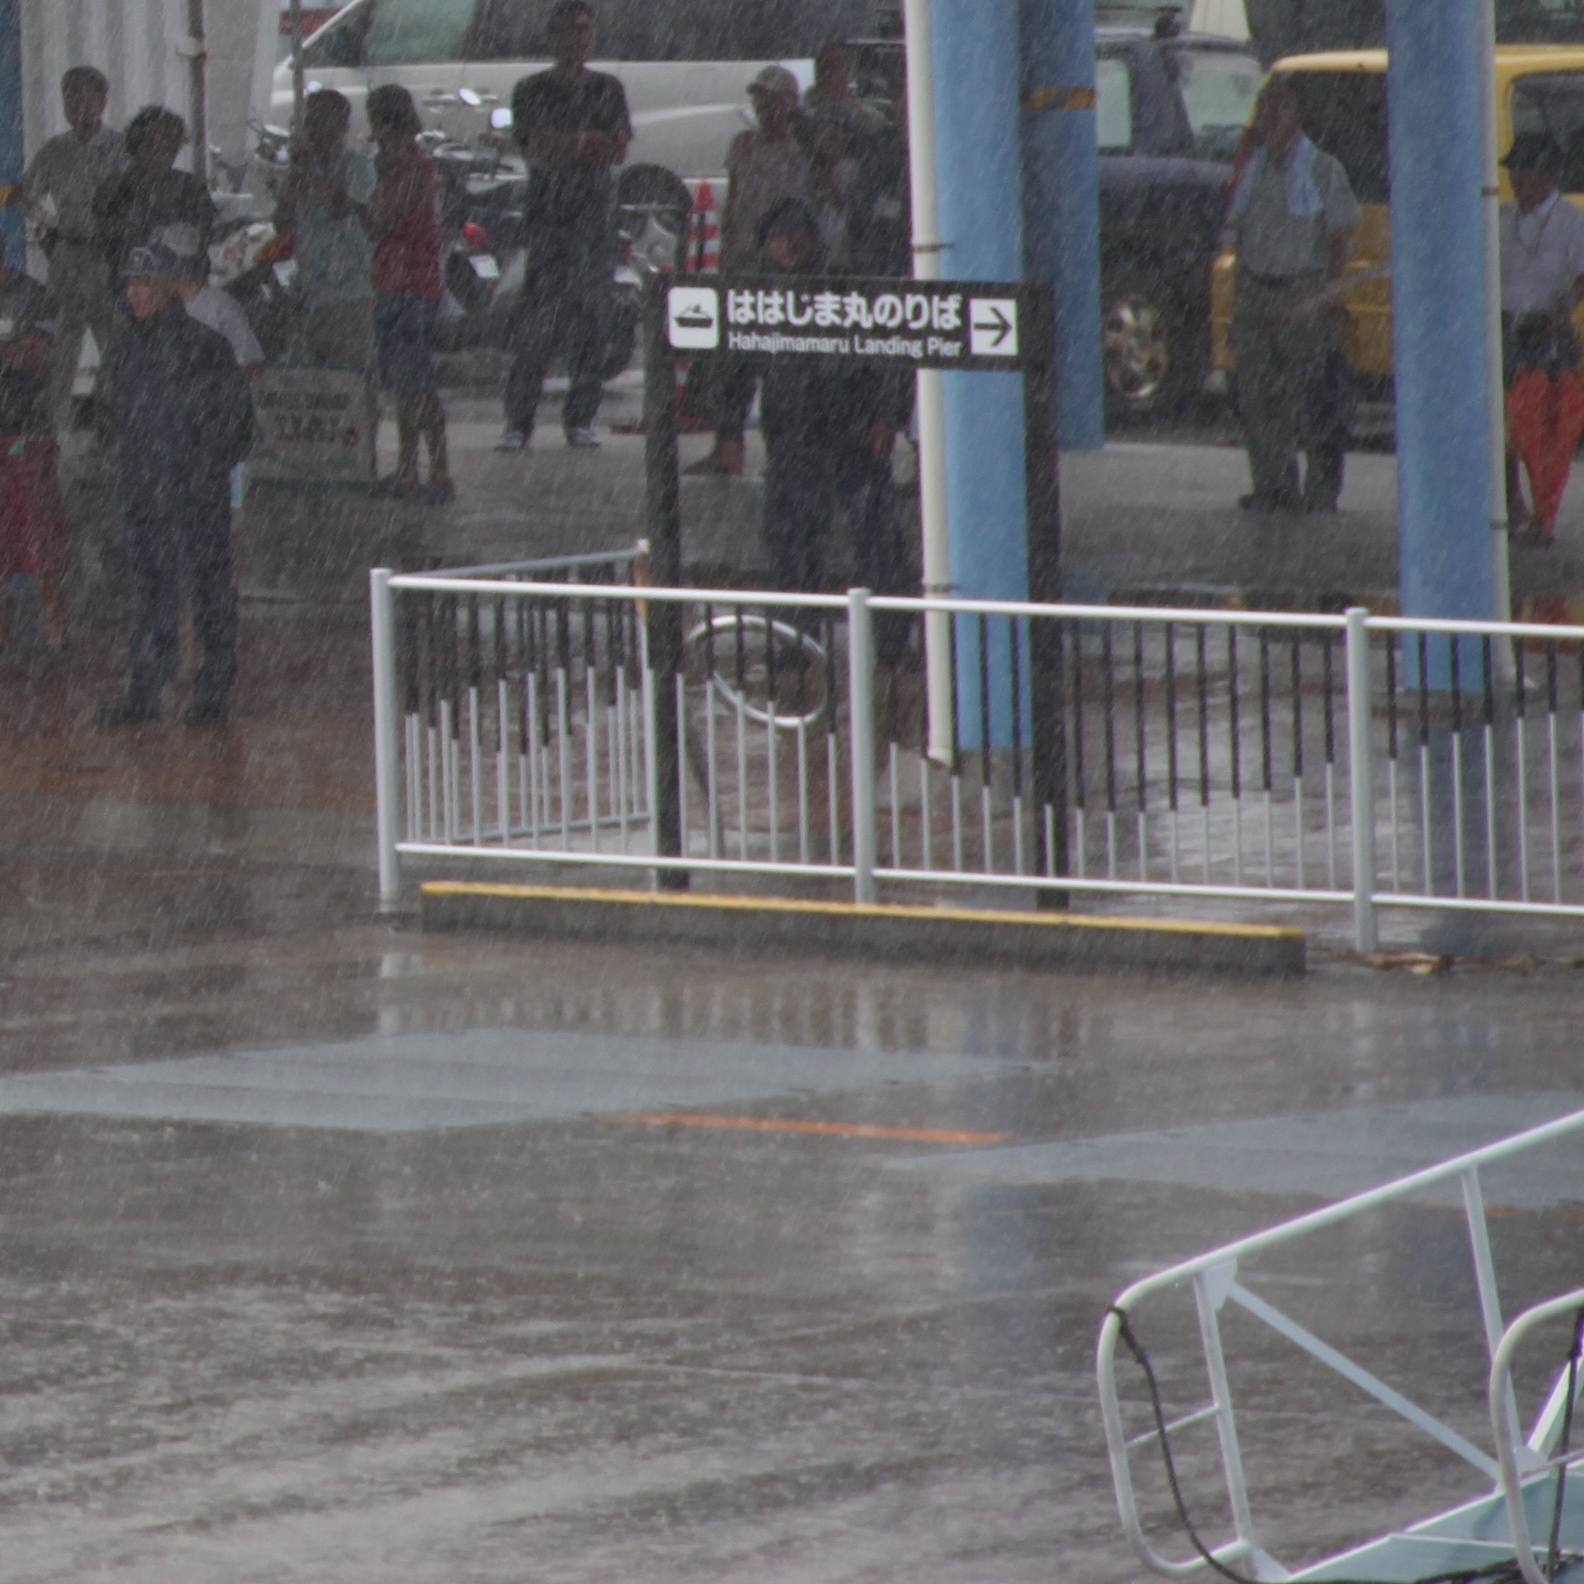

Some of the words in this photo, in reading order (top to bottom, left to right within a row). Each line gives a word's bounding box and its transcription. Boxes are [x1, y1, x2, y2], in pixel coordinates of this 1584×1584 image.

[727, 289, 962, 329] ははじま丸のりば
[728, 331, 850, 355] Hahajimamaru
[854, 335, 922, 358] Landing
[927, 337, 962, 357] Pier
